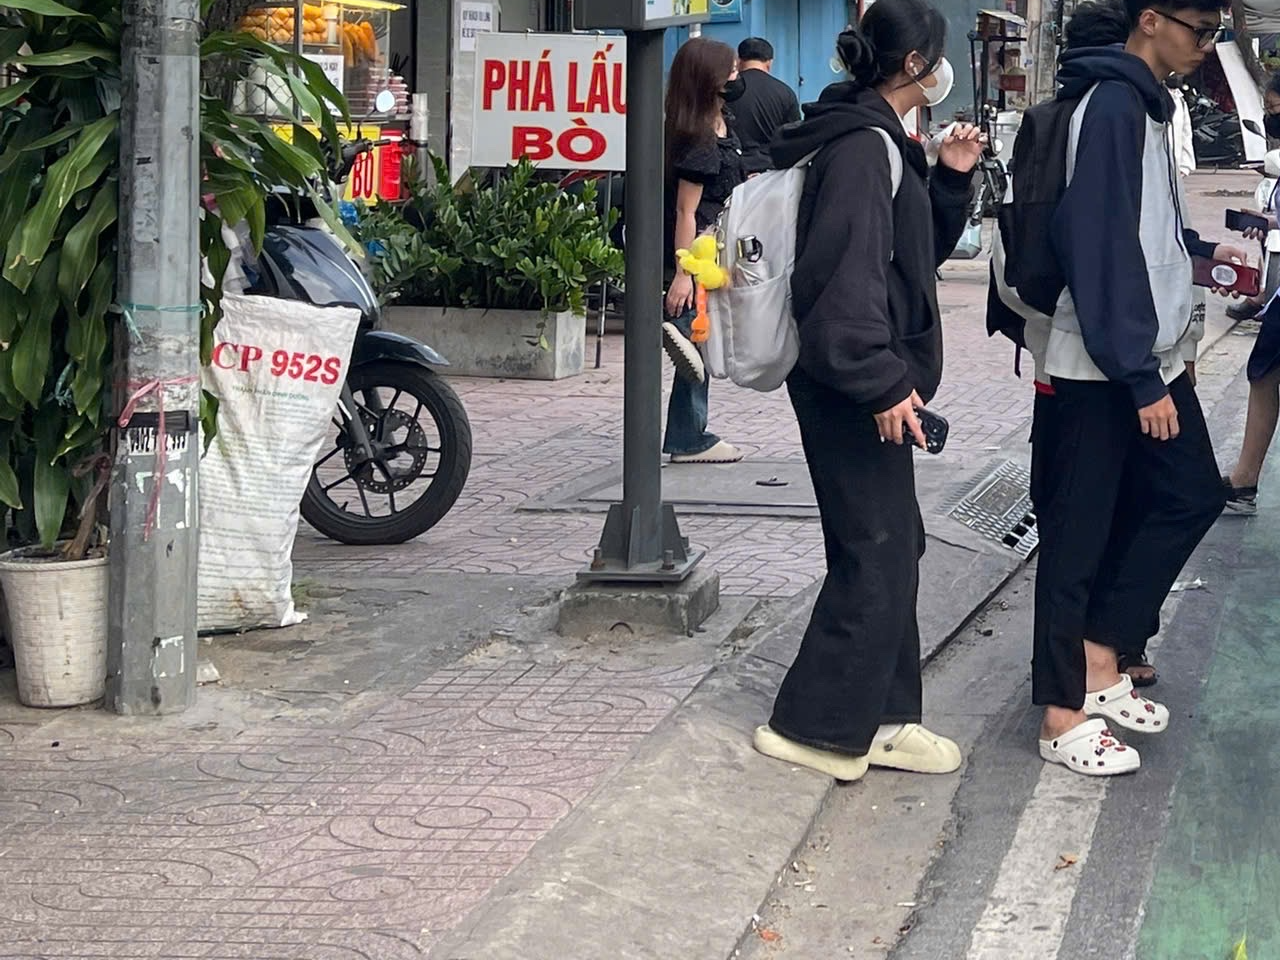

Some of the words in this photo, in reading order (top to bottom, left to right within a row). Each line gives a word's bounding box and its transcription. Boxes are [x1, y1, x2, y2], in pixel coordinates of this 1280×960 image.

[483, 50, 555, 112] PHÁ
[512, 118, 607, 162] BÒ
[212, 342, 263, 373] CP
[271, 349, 341, 385] 952S
